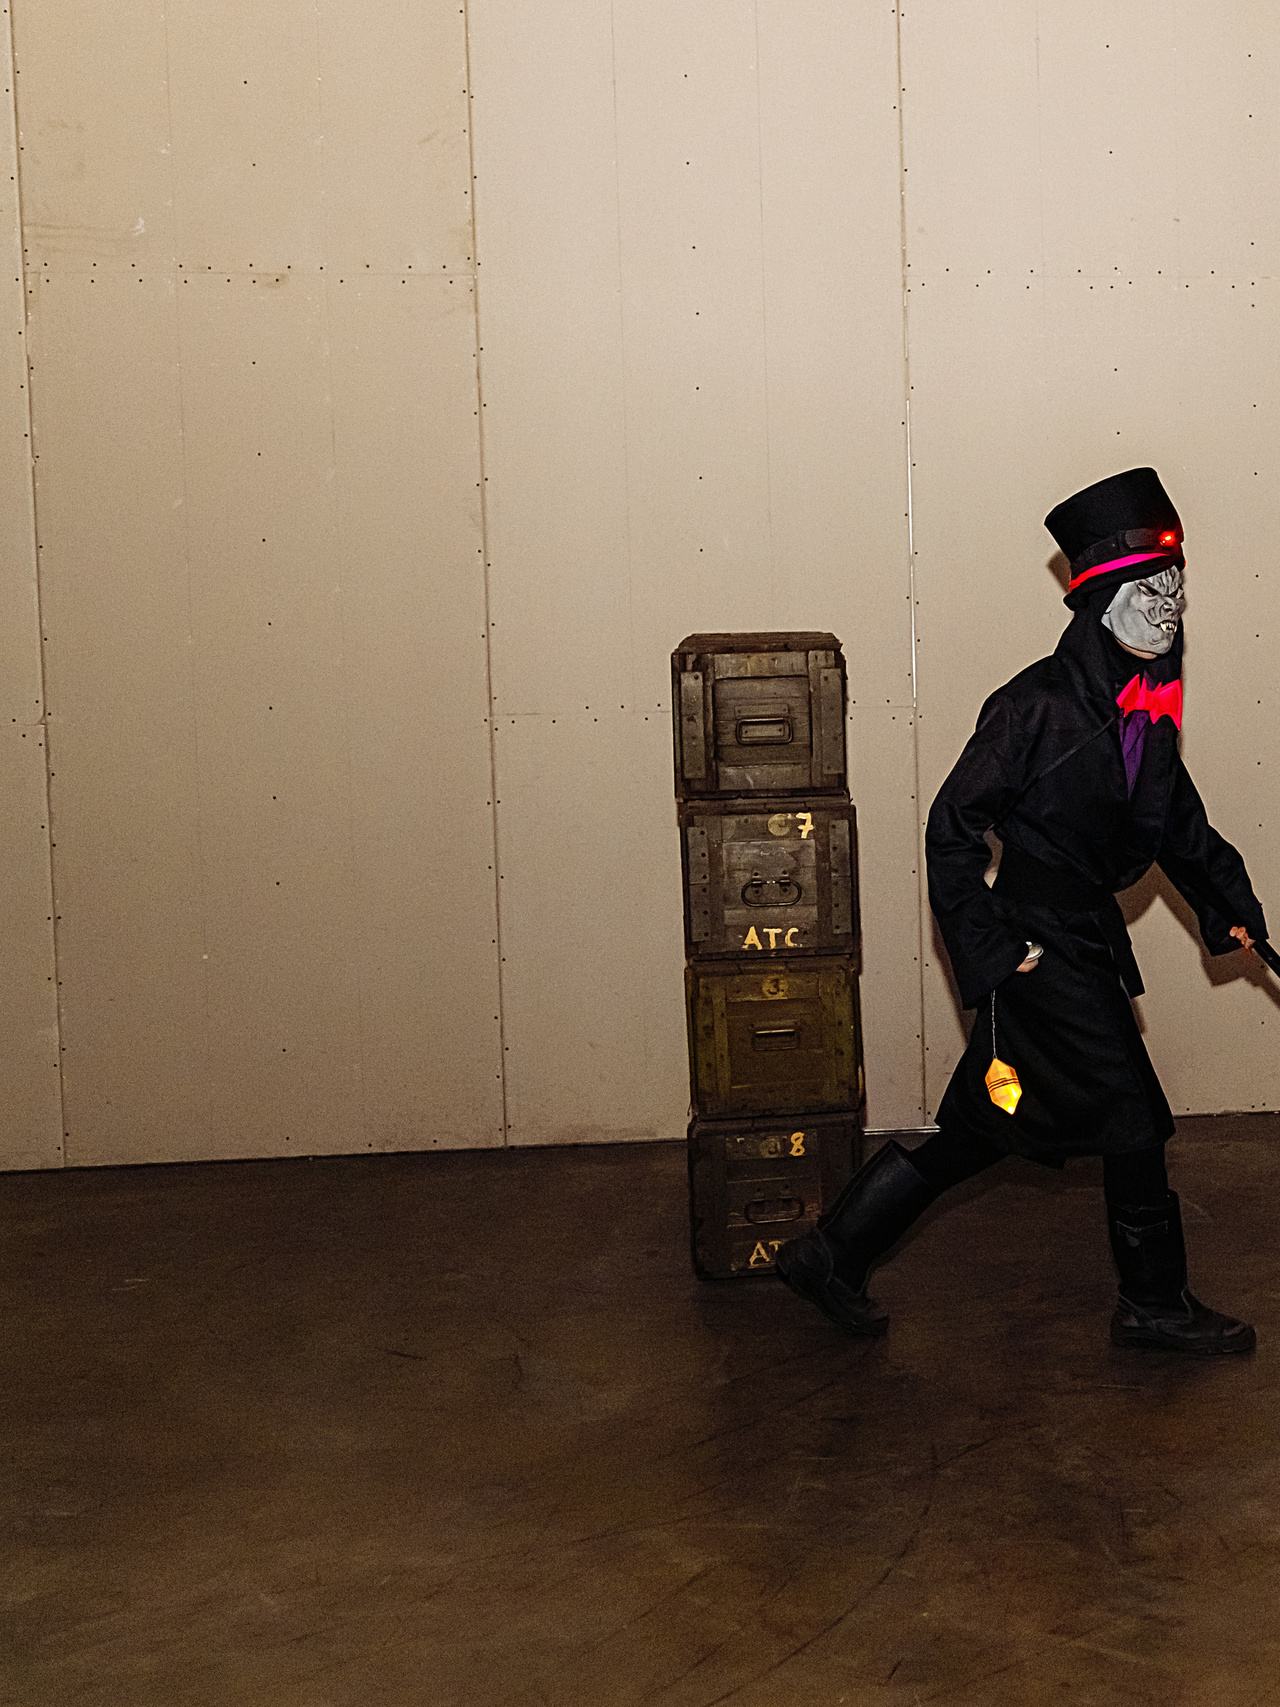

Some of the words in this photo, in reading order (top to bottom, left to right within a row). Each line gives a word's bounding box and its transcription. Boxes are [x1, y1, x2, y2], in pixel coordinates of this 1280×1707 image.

[795, 812, 815, 839] 7
[742, 925, 801, 950] ATC
[789, 1131, 806, 1157] 8
